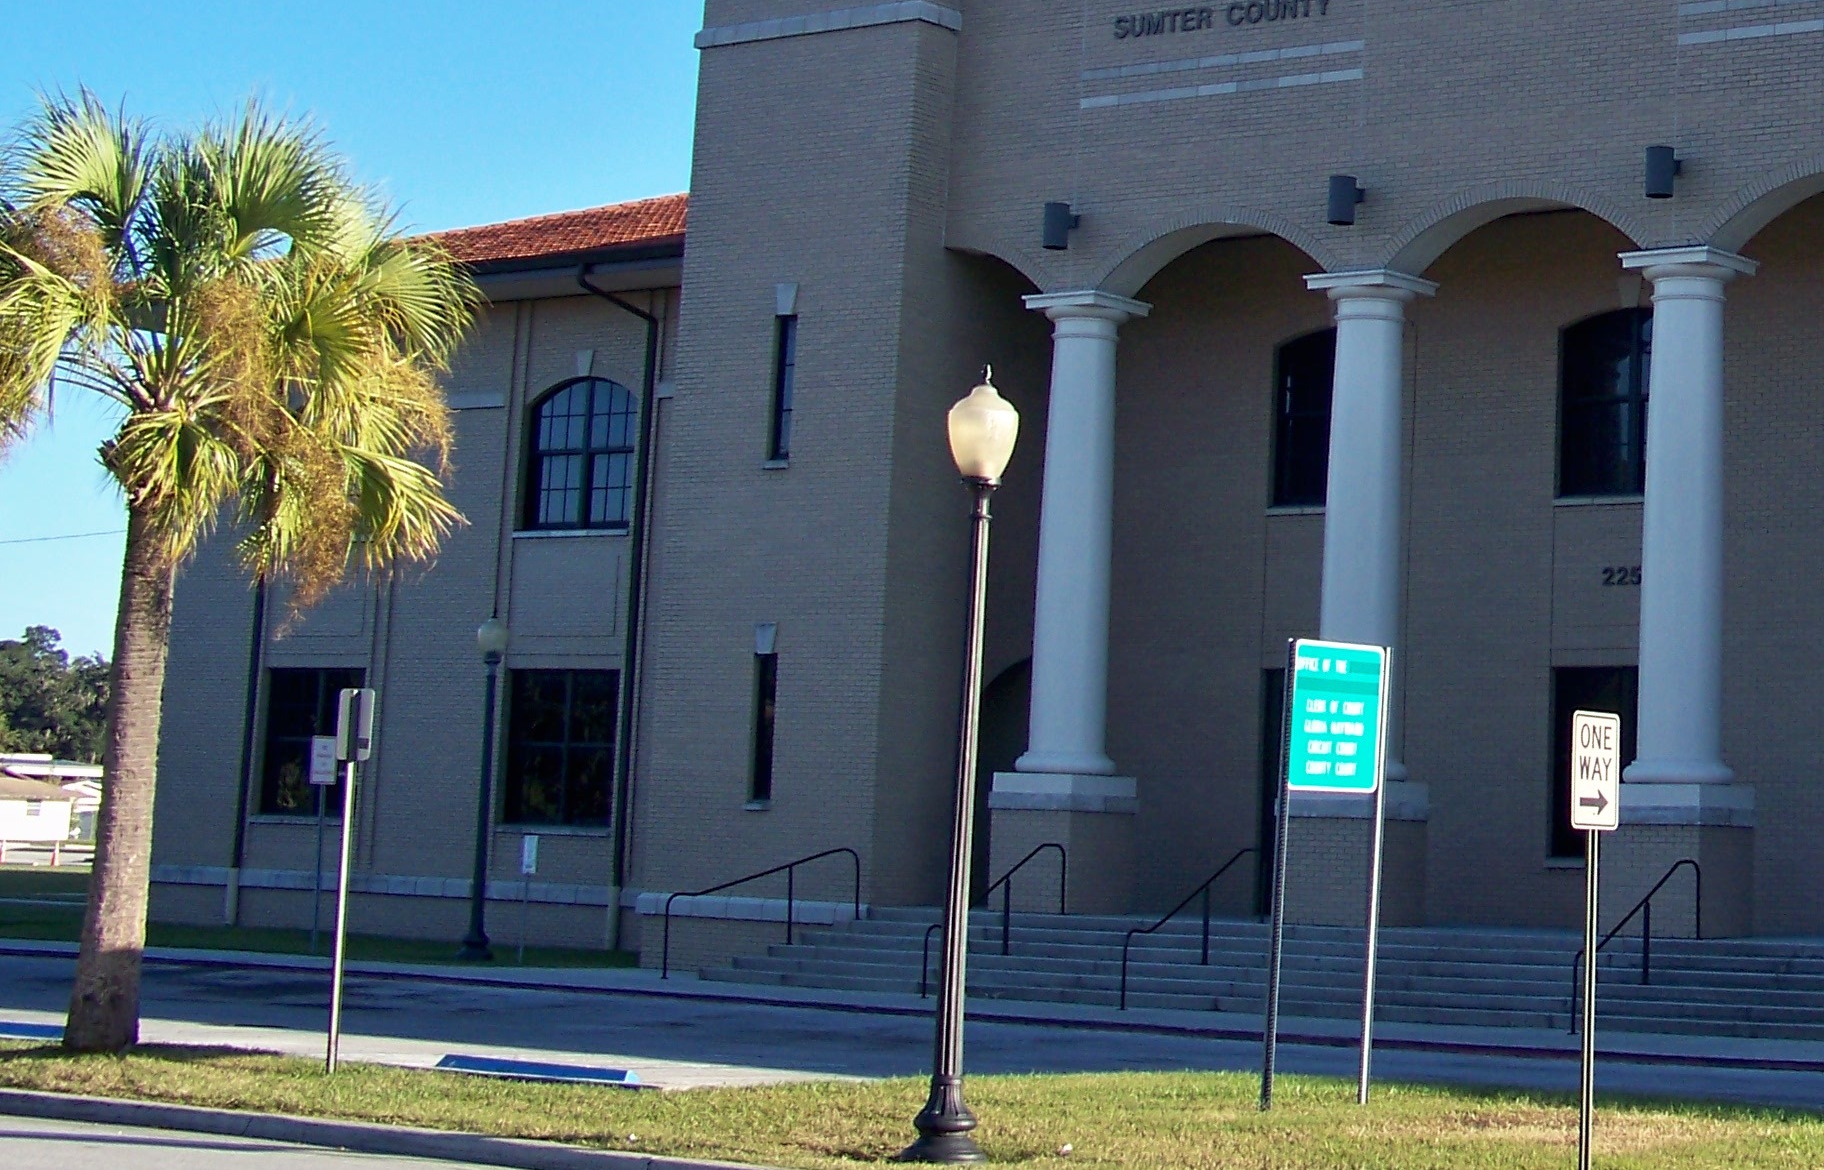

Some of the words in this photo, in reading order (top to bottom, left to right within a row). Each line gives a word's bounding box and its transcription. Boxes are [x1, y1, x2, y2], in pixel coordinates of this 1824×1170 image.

[1113, 7, 1213, 39] SUMTER
[1602, 566, 1642, 586] 225
[1297, 657, 1319, 672] OFFICE
[1322, 659, 1331, 672] OF
[1306, 698, 1326, 713] CLERK
[1580, 723, 1612, 751] ONE
[1579, 755, 1612, 781] WAY
